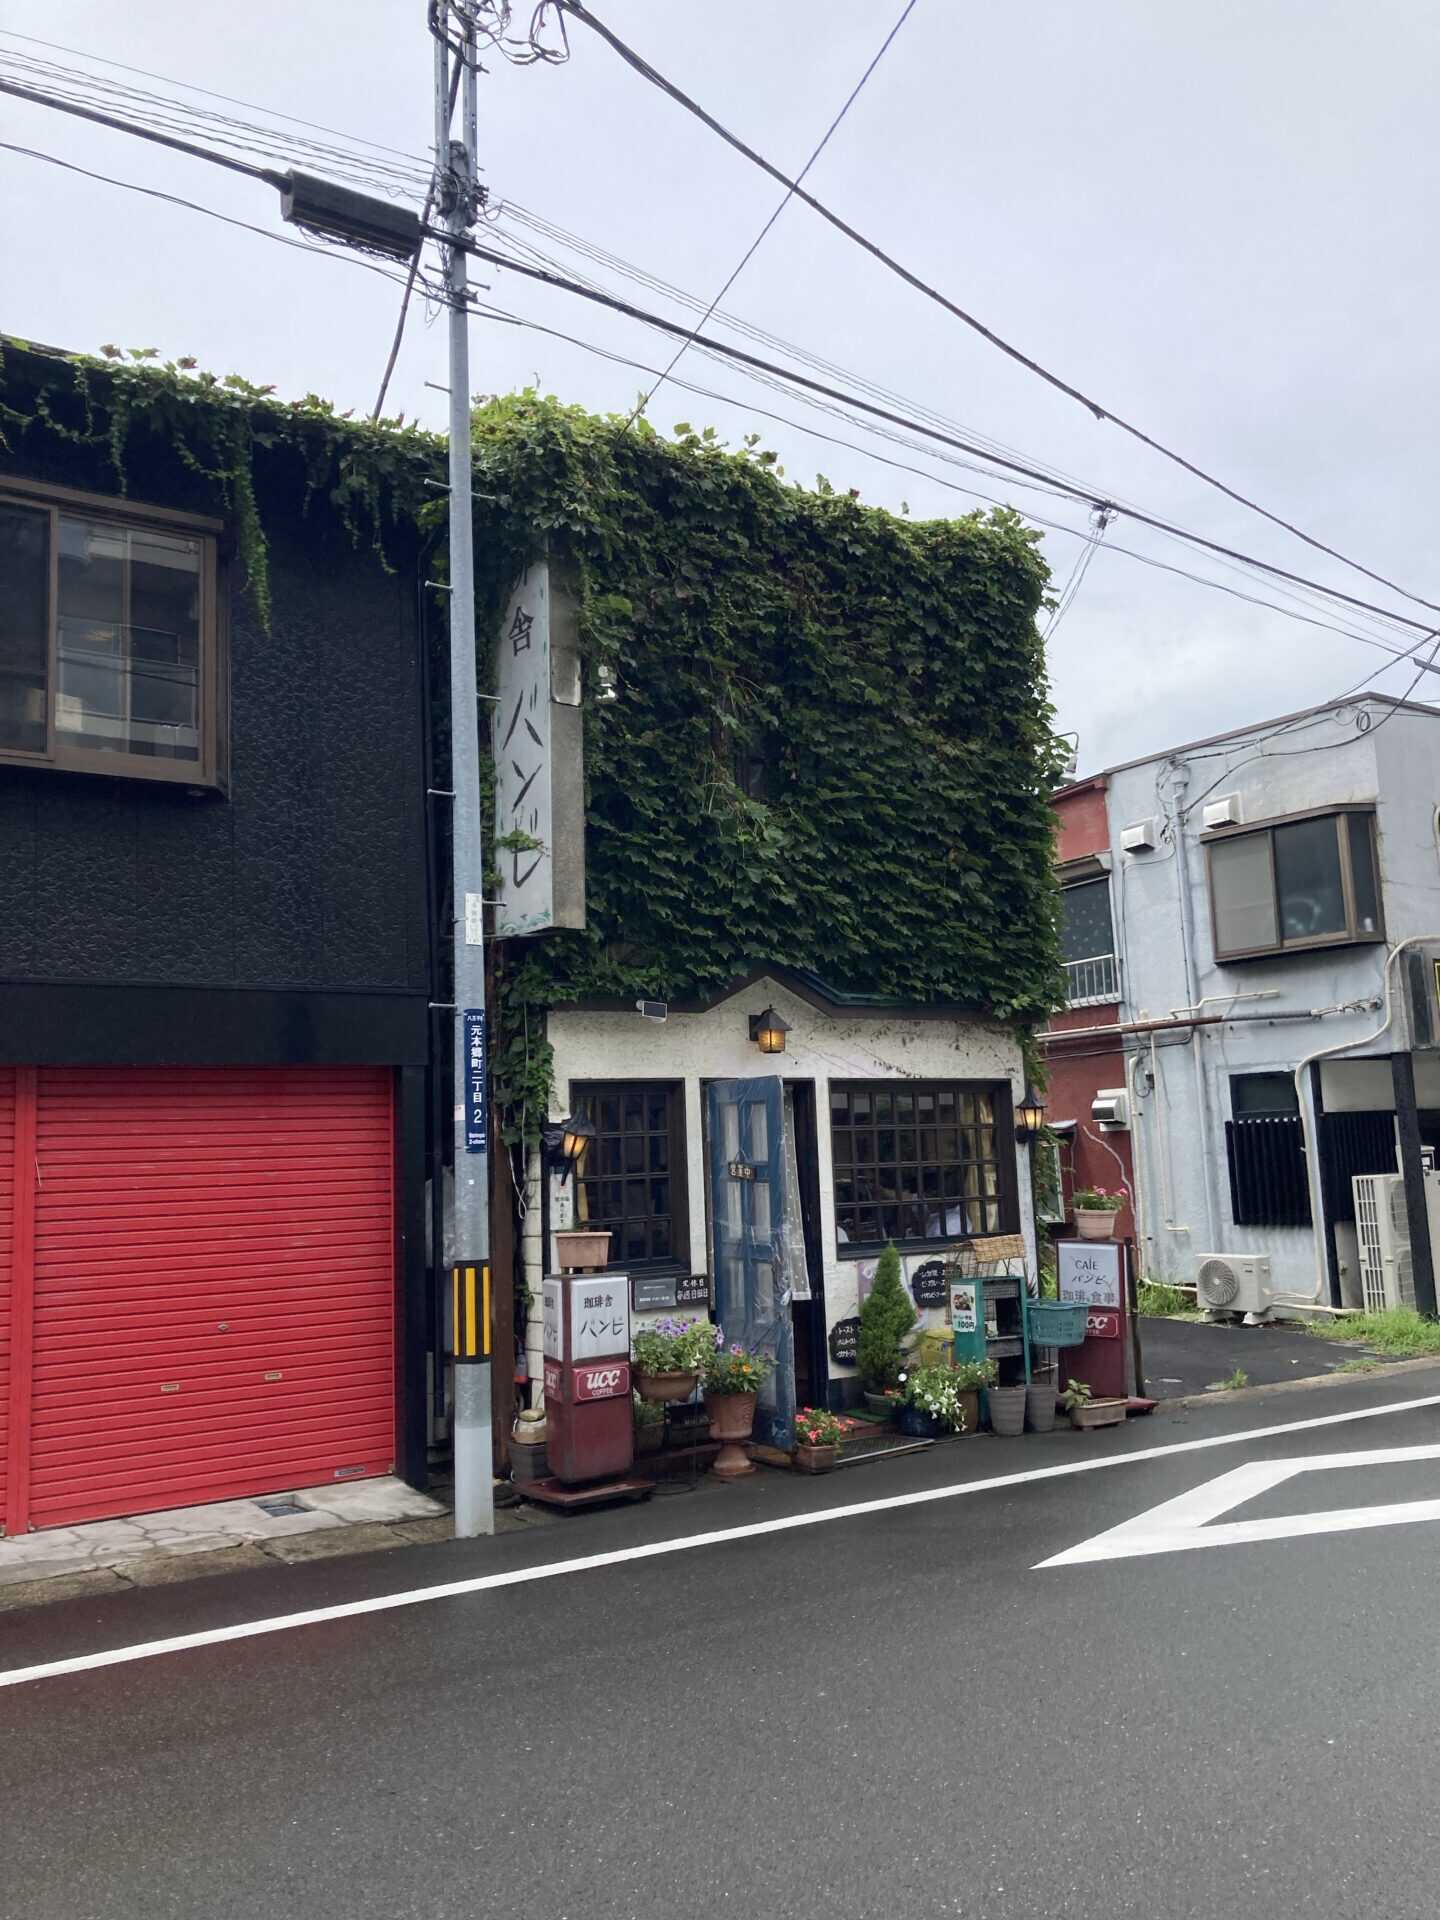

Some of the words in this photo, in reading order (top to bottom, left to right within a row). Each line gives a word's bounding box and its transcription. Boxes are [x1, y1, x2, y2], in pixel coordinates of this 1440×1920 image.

[473, 1109, 482, 1123] 2
[581, 1317, 624, 1338] バンビ
[1087, 1316, 1108, 1329] CC
[586, 1370, 620, 1389] UCC
